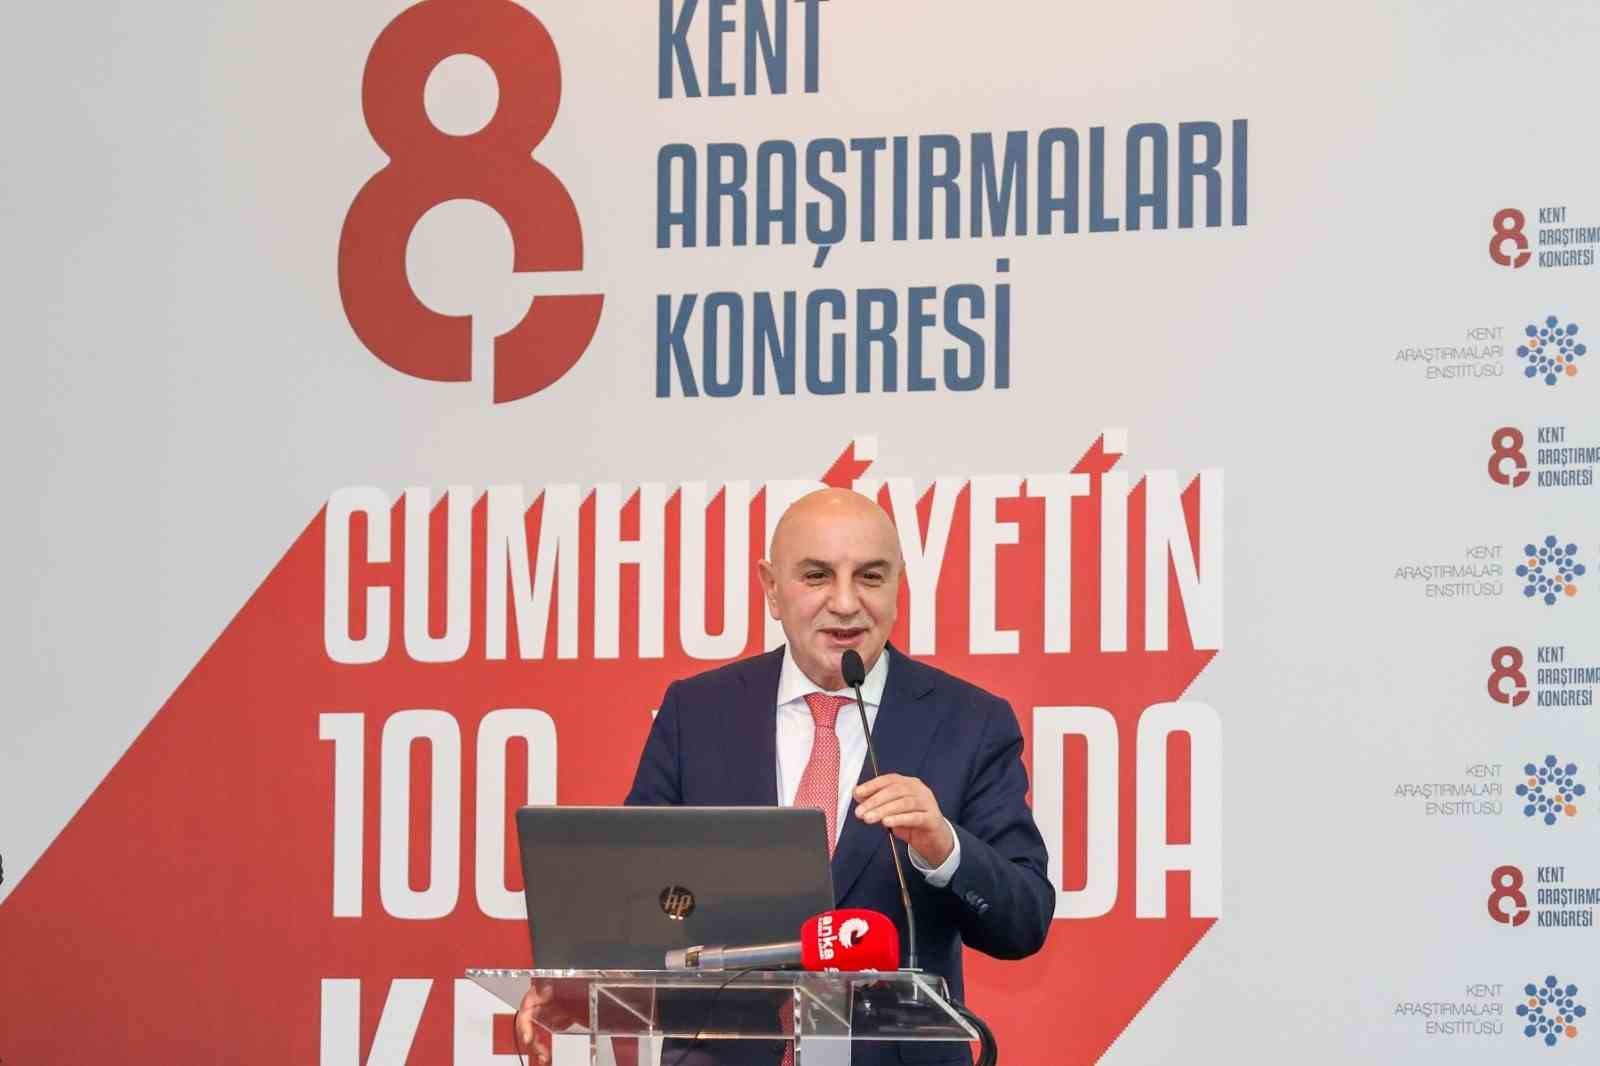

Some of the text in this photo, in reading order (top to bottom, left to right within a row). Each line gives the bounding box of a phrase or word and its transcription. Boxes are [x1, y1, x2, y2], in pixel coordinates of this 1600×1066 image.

[658, 0, 830, 99] KENT
[338, 0, 605, 405] 8
[656, 119, 1248, 269] ARAŞTIRMALARI
[1539, 207, 1566, 223] KENT
[1489, 208, 1531, 268] 8
[1538, 245, 1594, 267] KONGRESİ
[656, 259, 1011, 398] KONGRESİ
[1466, 327, 1504, 340] KENT
[1395, 345, 1504, 363] ARAŞTIRMALARI
[1538, 427, 1565, 443] KENT
[1488, 427, 1530, 488] 8
[1538, 466, 1592, 487] KONGRESİ
[323, 428, 1225, 664] CUMHUYETİN
[1466, 546, 1503, 559] KENT
[1394, 564, 1503, 581] ARAŞTIRMALARI
[1537, 646, 1564, 663] KENT
[1488, 646, 1530, 707] 8
[1537, 686, 1592, 707] KONGRESİ
[1465, 765, 1503, 777] KENT
[1393, 783, 1503, 799] ARAŞTIRMALARI
[319, 708, 557, 920] 100
[1537, 867, 1564, 883] KENT
[664, 885, 692, 919] hp
[1488, 865, 1530, 927] 8
[1537, 906, 1592, 927] KONGRESİ
[1466, 985, 1504, 997] KENT
[1395, 1003, 1503, 1018] ARAŞTIRMALARI
